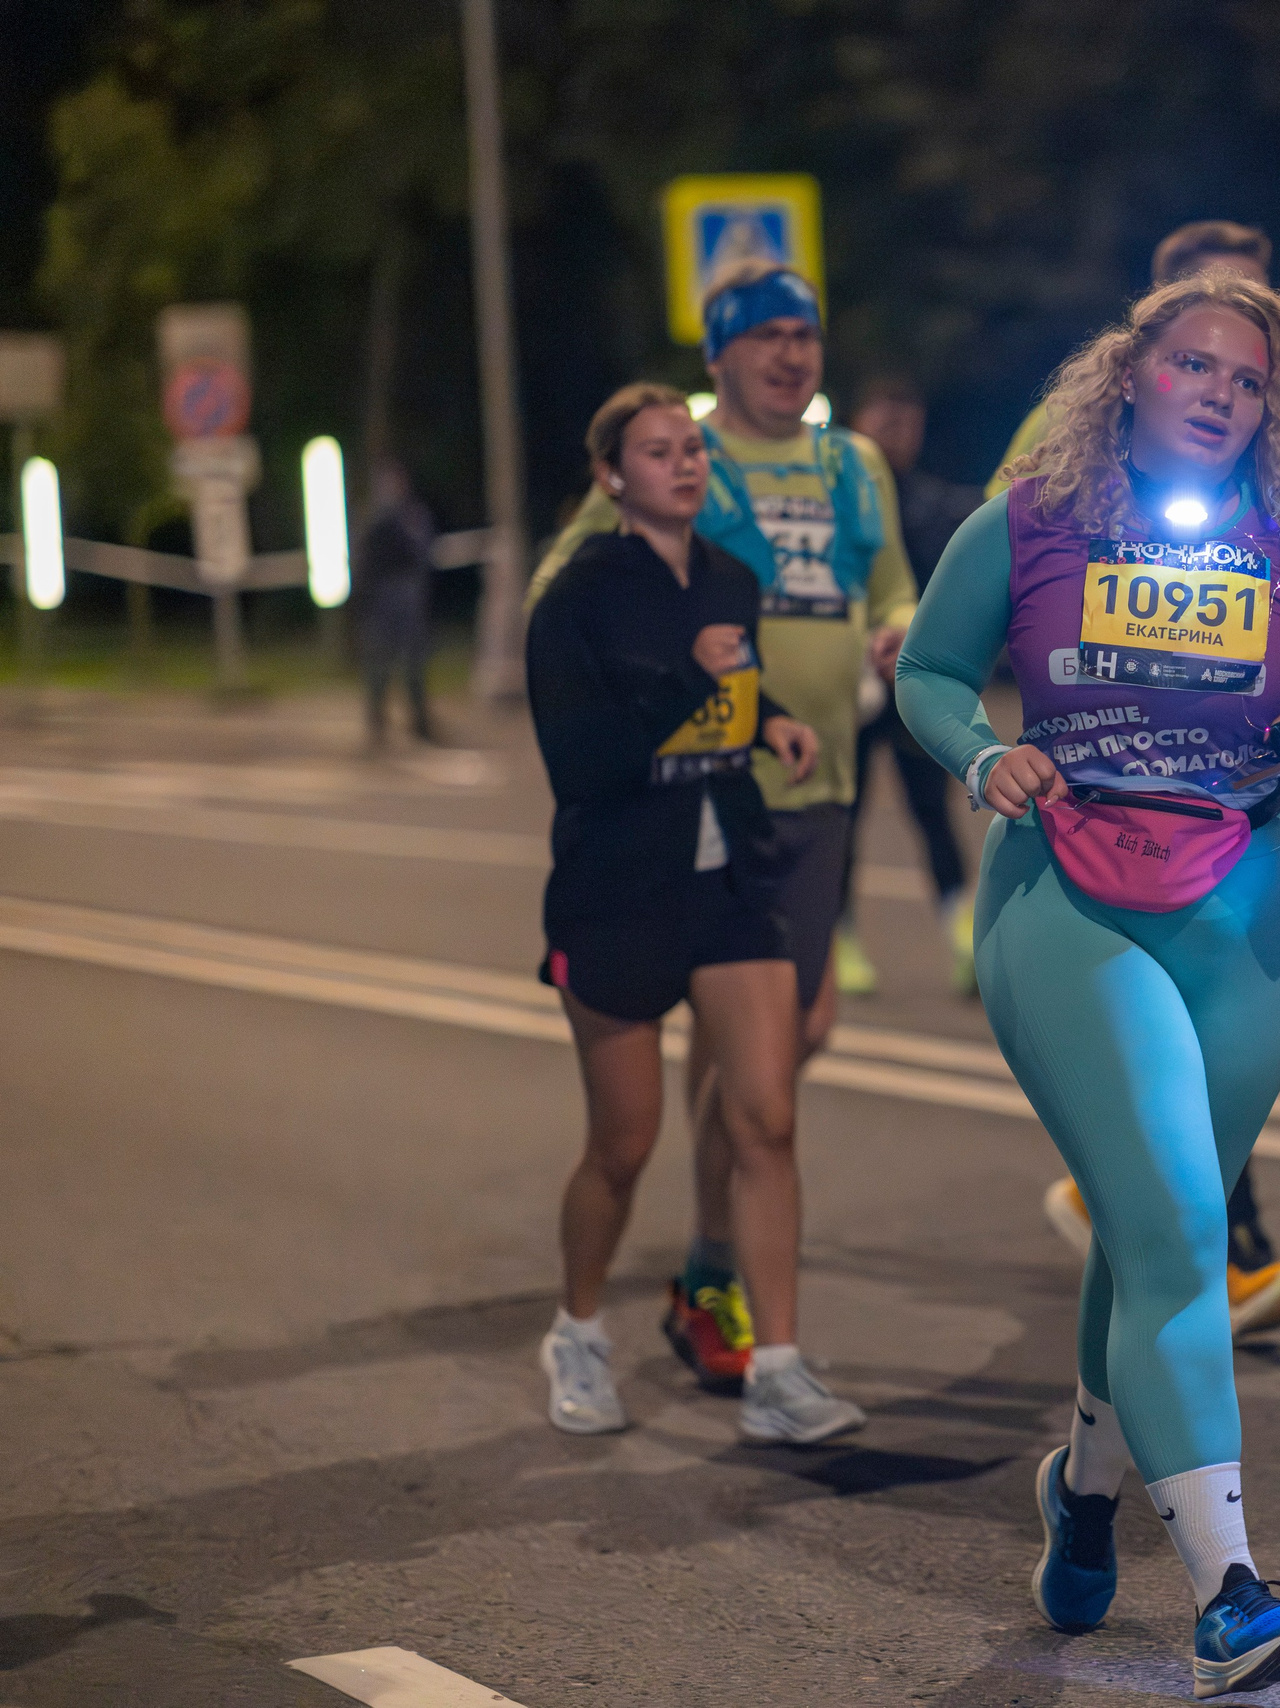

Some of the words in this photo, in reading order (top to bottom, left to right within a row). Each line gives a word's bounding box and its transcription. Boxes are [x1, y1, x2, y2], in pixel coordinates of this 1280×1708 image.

[1112, 539, 1258, 570] НОЧНОЙ
[1097, 574, 1256, 631] 10951
[1125, 622, 1224, 647] ЕКАТЕРИНА
[1042, 705, 1150, 735] БОЛЬШЕ,
[1053, 740, 1099, 765] ЧЕМ
[1098, 728, 1209, 758] ПРОСТО
[1114, 831, 1139, 854] Rich
[1140, 839, 1172, 863] Bitch
